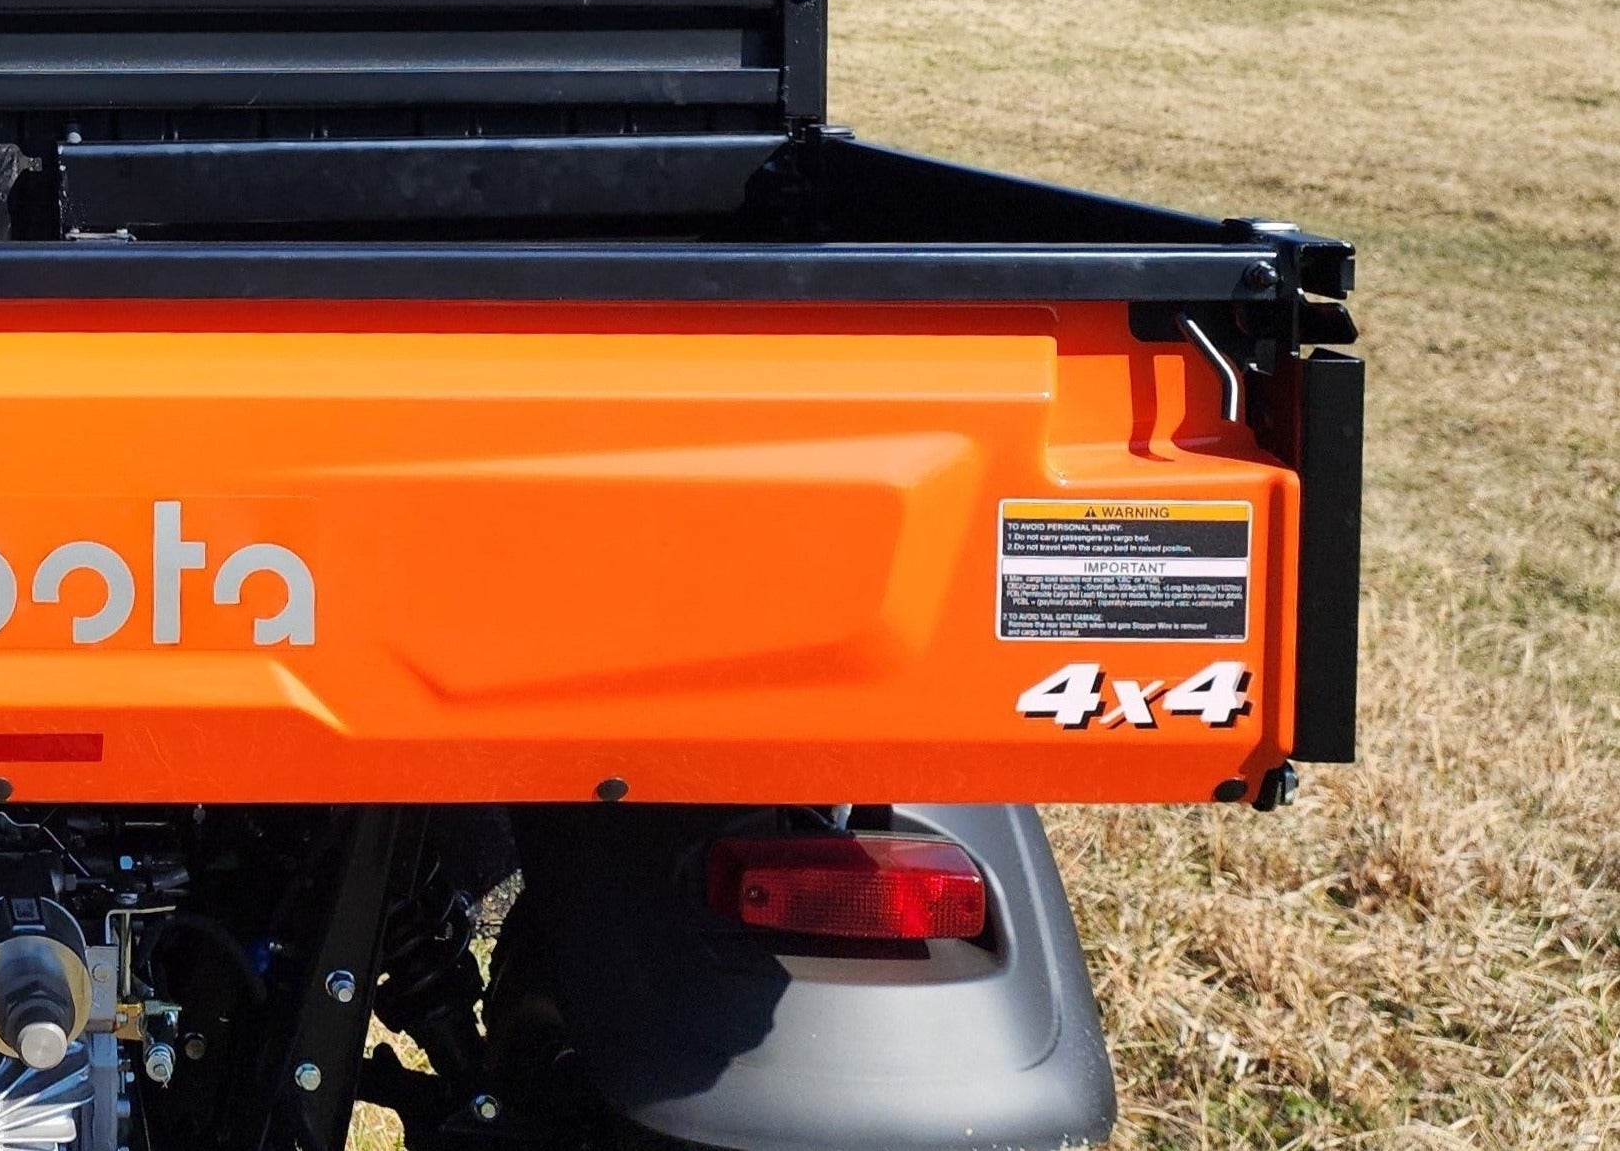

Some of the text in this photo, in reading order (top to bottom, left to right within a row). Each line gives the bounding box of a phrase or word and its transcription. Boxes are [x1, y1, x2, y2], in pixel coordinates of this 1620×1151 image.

[1102, 506, 1170, 518] WARNING
[1006, 523, 1020, 531] TO
[1020, 523, 1046, 531] AVOID
[1046, 523, 1090, 531] PERSONAL
[1040, 534, 1060, 542] carry
[1060, 534, 1102, 543] passengers
[1112, 534, 1134, 543] cargo
[1026, 543, 1039, 551] not
[1040, 543, 1060, 551] travel
[1062, 544, 1078, 552] with
[1078, 544, 1092, 552] the
[1092, 544, 1112, 553] cargo
[1114, 544, 1128, 552] bed
[1130, 544, 1138, 552] in
[1138, 544, 1162, 552] raised
[1084, 562, 1166, 573] IMPORTANT
[1015, 661, 1253, 729] 4x4
